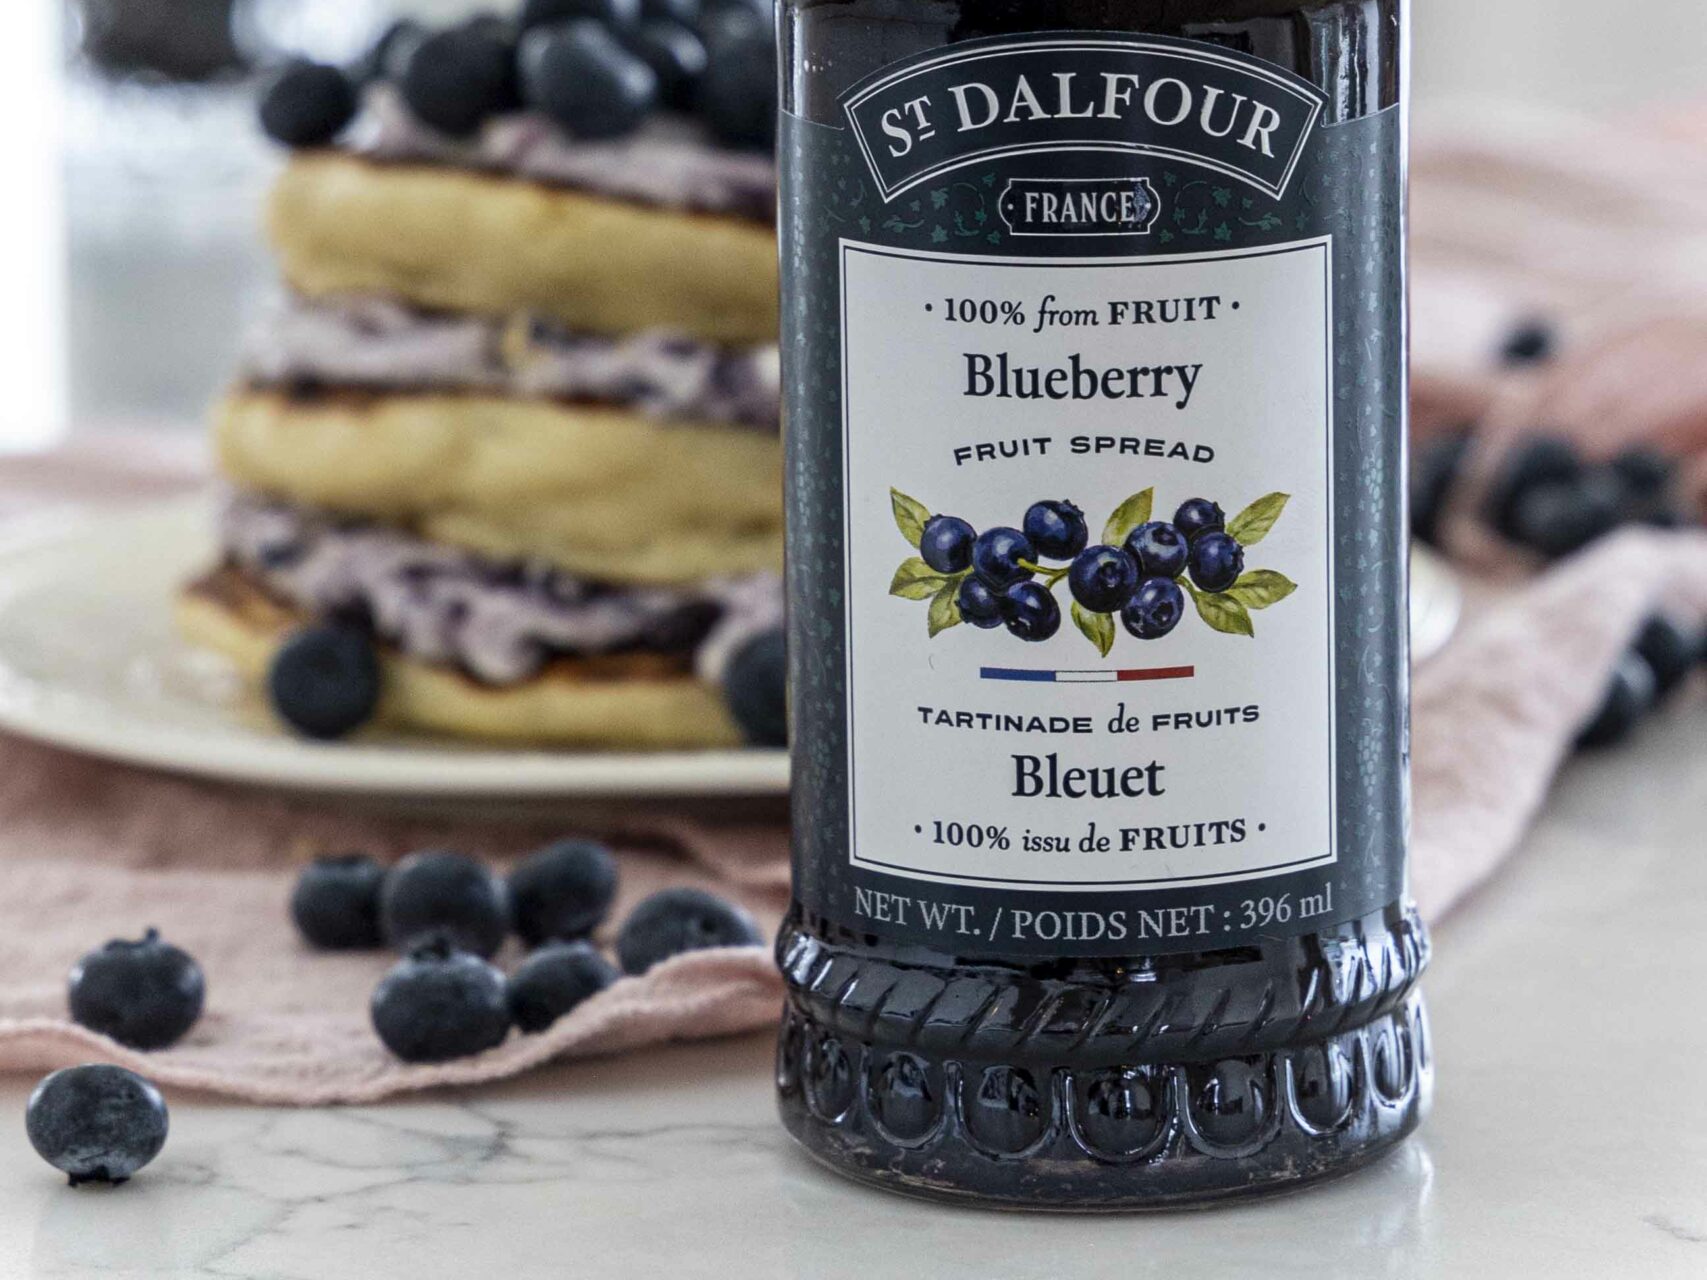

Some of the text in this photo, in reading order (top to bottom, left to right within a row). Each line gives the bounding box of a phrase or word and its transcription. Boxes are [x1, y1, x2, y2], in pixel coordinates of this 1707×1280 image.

[880, 71, 1283, 158] ST DALFOUR
[1025, 192, 1135, 224] FRANCE
[945, 294, 1221, 334] 100% from FRUIT
[962, 351, 1203, 410] Blueberry
[953, 435, 1215, 466] FRUIT SPREAD
[917, 702, 1260, 734] TARTINADE de FRUITS
[1011, 752, 1166, 799] Bleuet
[933, 818, 1246, 853] 100% issu de FRUITS
[854, 886, 912, 926] NET
[916, 899, 981, 936] WT.
[1010, 909, 1127, 940] POIDS
[1240, 892, 1292, 929] 396
[1299, 881, 1334, 919] ml
